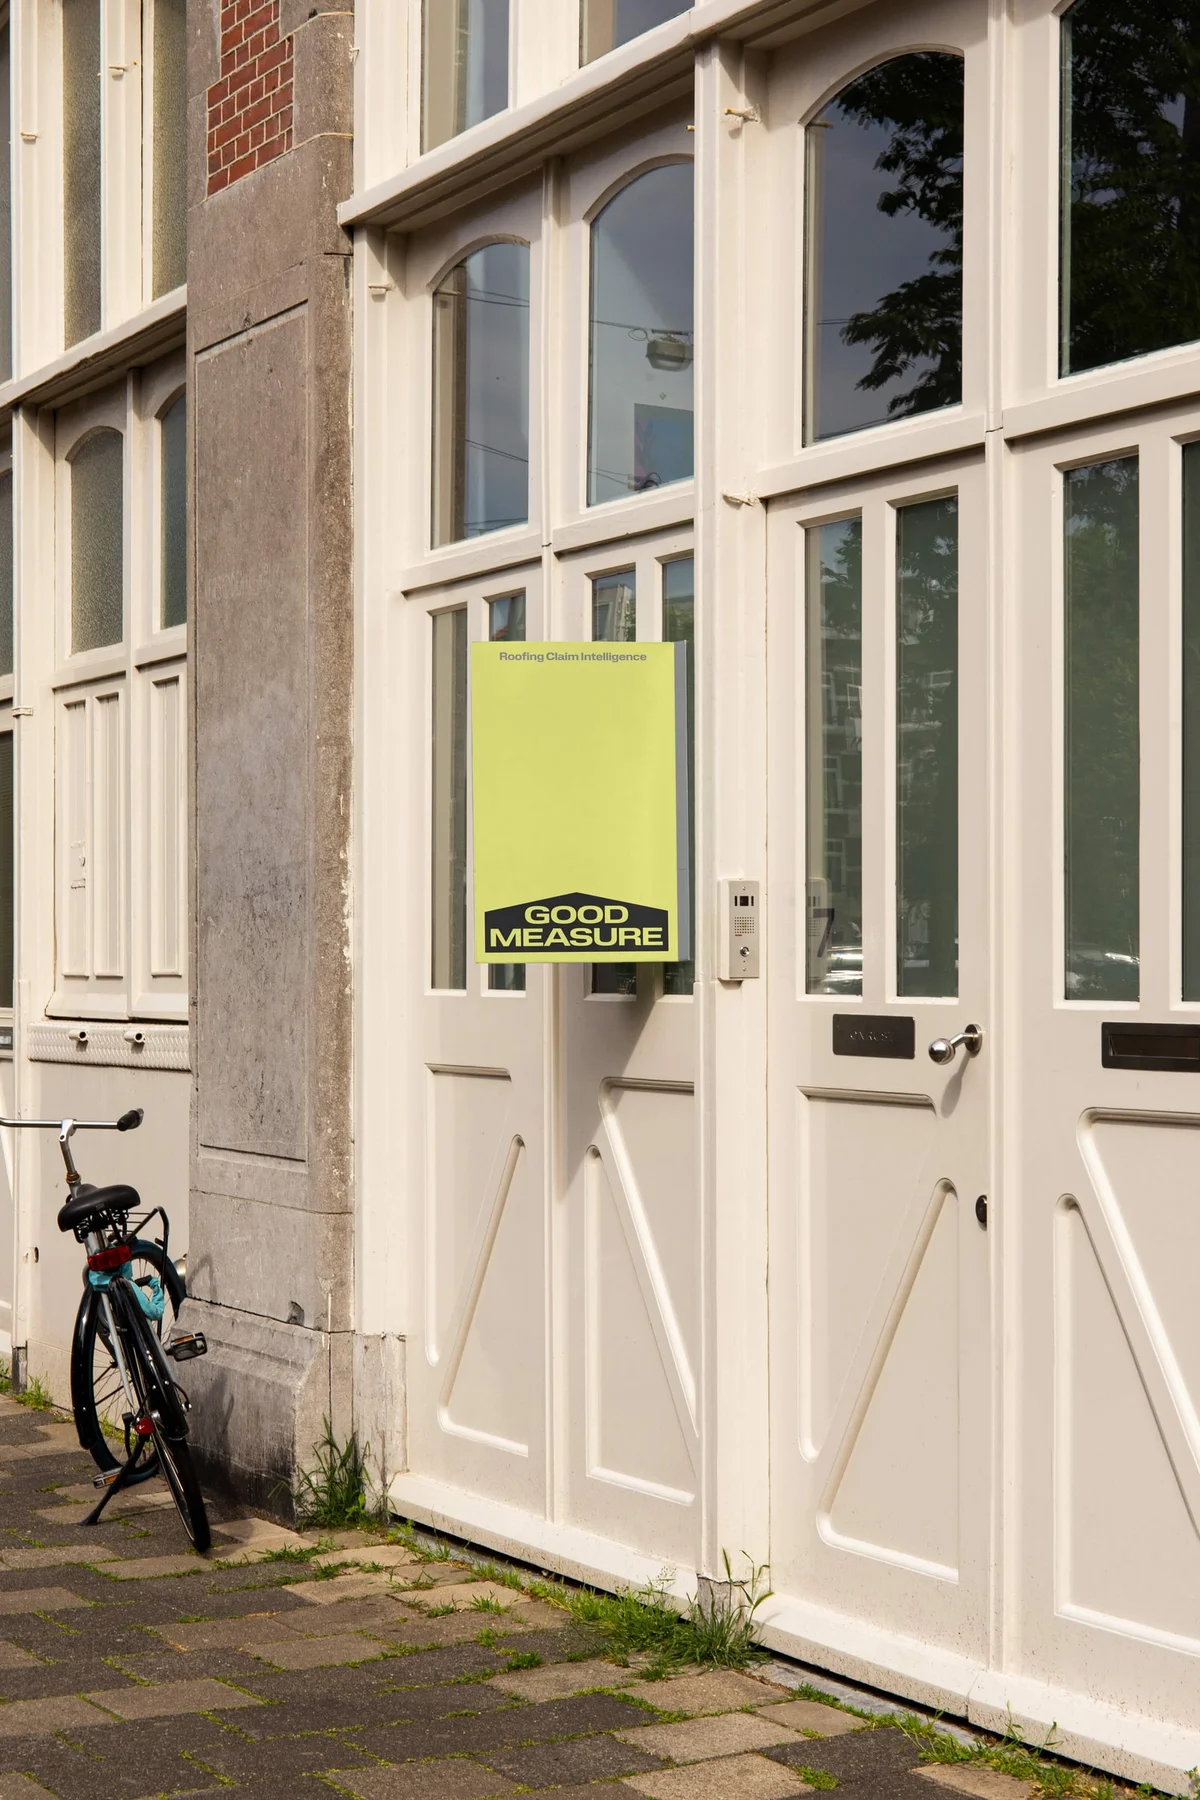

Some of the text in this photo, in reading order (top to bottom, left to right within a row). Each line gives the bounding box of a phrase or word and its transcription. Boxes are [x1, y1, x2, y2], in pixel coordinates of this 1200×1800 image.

[499, 652, 647, 663] Roofing Claim Intelligence
[524, 905, 629, 925] GOOD
[490, 927, 663, 947] MEASURE
[813, 908, 835, 958] 7
